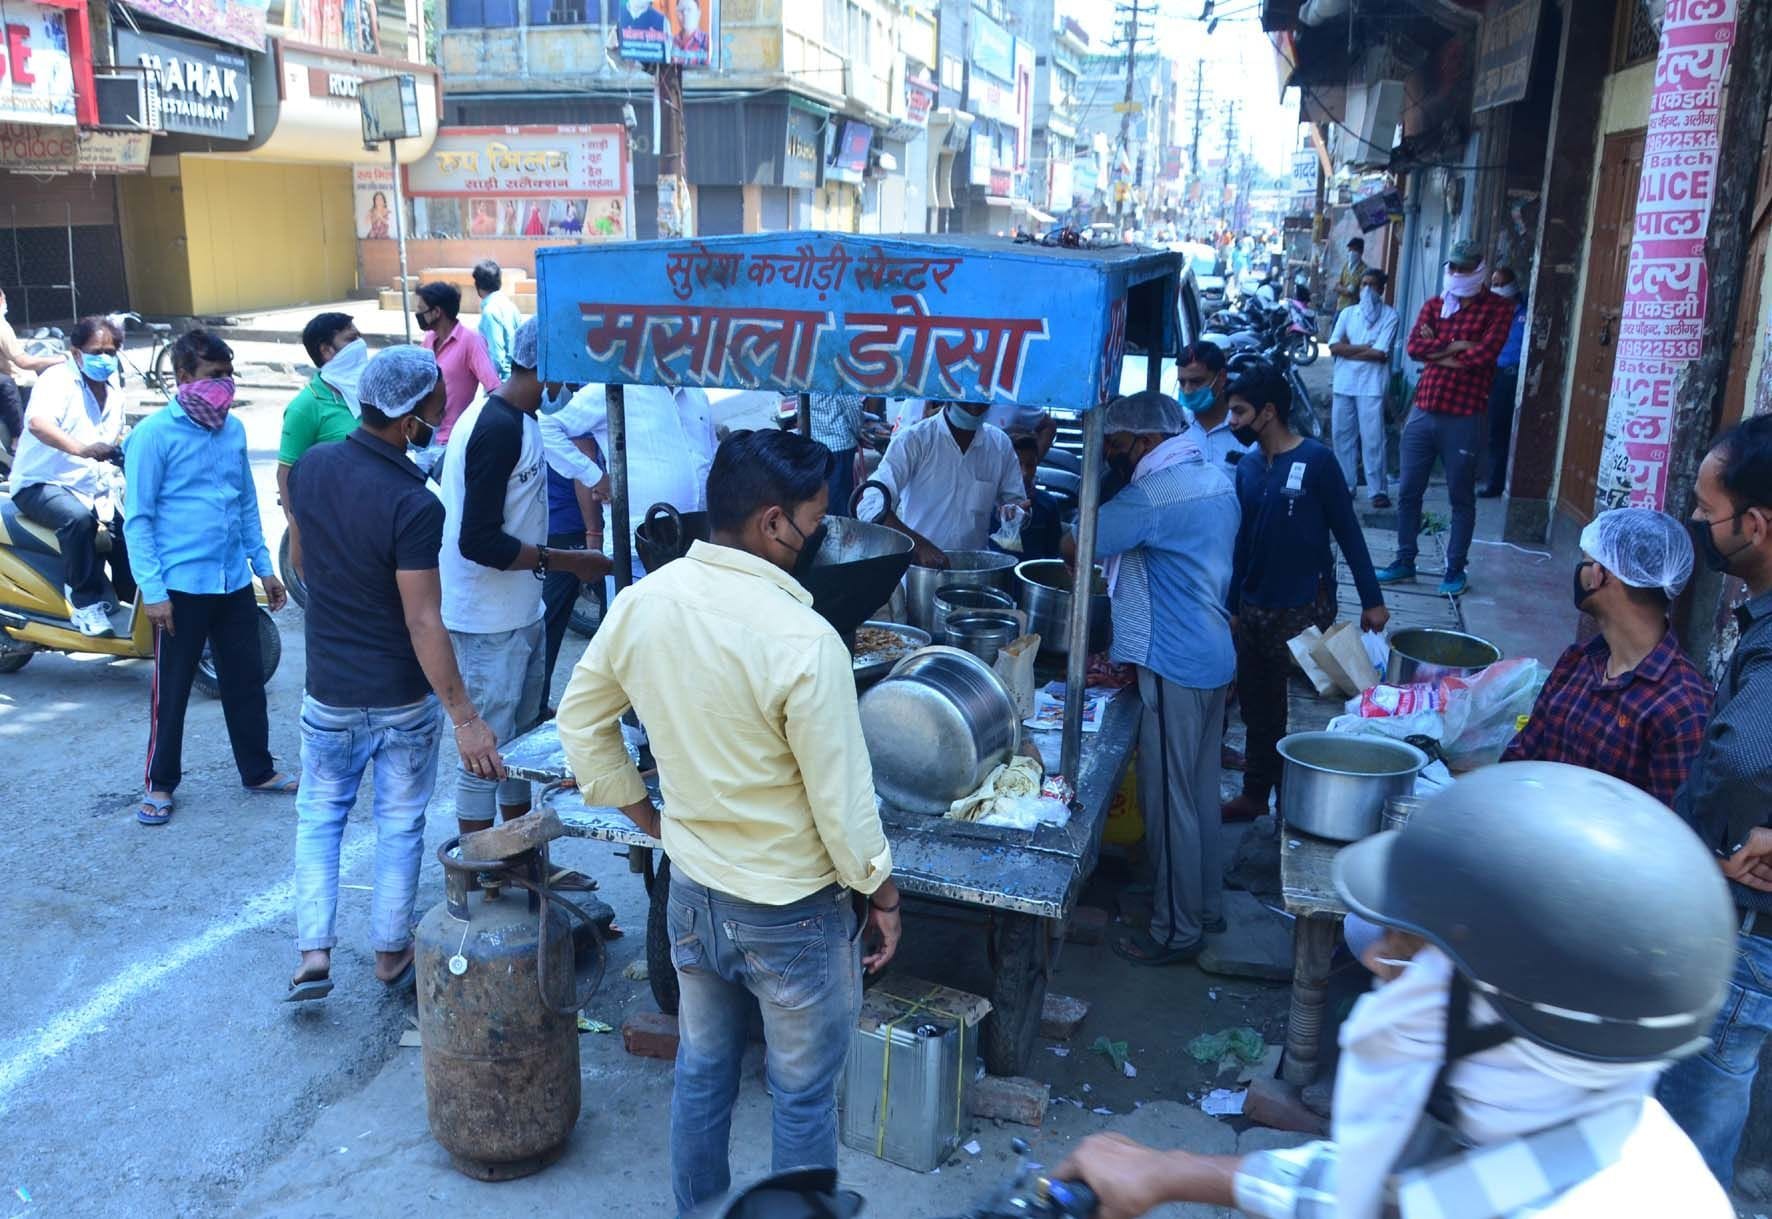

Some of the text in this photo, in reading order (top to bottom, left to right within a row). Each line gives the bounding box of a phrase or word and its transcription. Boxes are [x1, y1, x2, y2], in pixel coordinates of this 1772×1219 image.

[138, 52, 239, 103] MAHAK
[329, 73, 363, 98] ROO
[157, 96, 229, 121] RESTAURANT
[1, 137, 73, 159] Palace
[1651, 152, 1713, 168] Batch
[666, 241, 744, 300] सुरेश
[747, 244, 853, 301] कचौड़ी
[578, 302, 836, 390] मसाला
[833, 293, 1051, 402] डोसा
[1619, 360, 1675, 375] Batch
